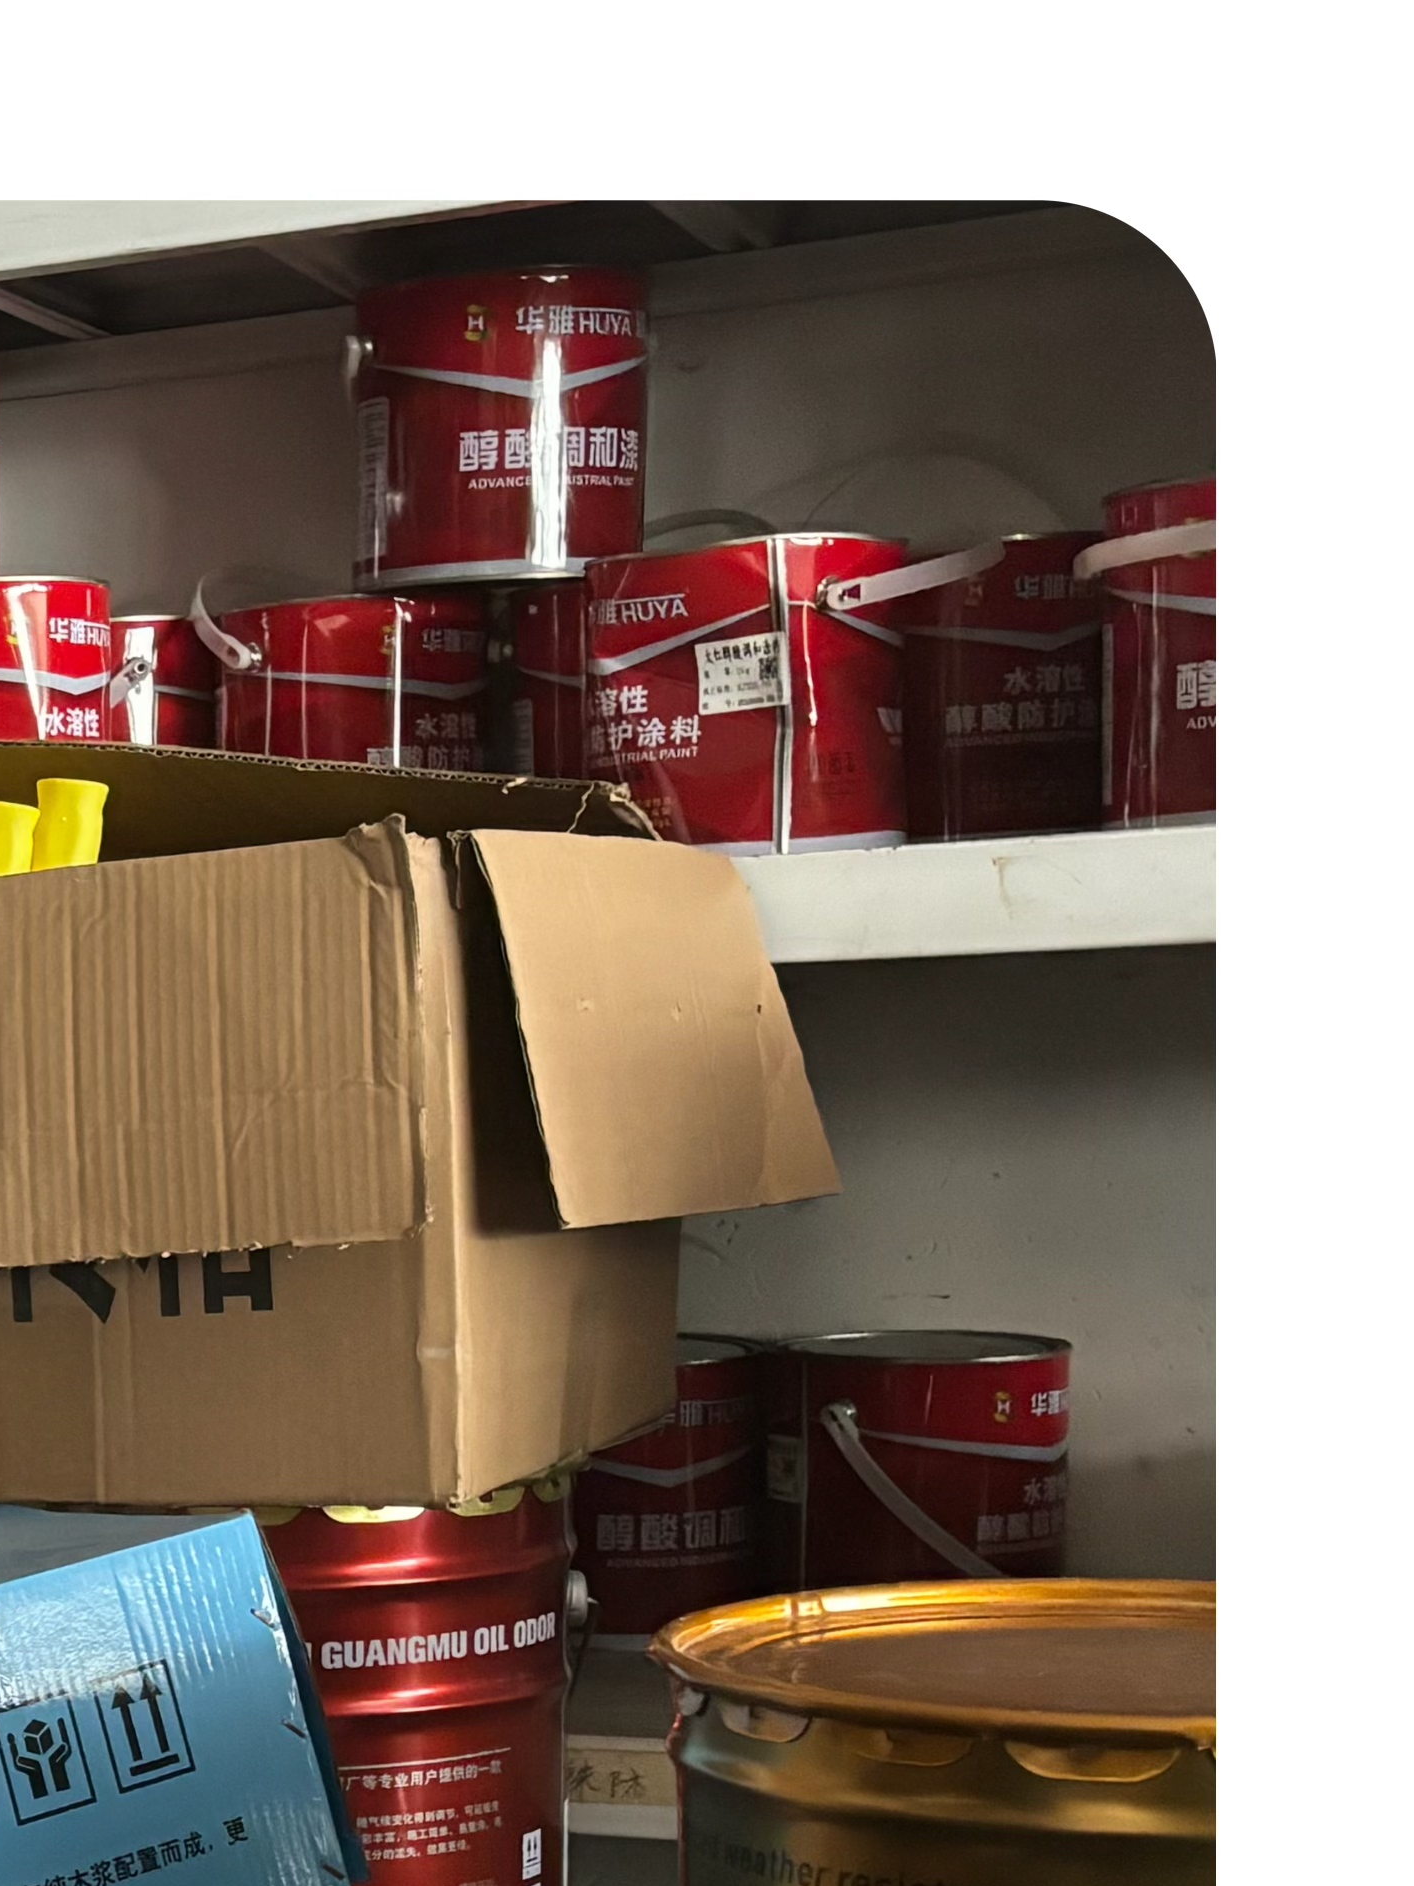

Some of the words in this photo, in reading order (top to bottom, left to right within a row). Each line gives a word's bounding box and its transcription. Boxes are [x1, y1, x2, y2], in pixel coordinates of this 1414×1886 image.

[468, 475, 533, 490] ADVANCE
[321, 1630, 468, 1671] GUANGMU
[473, 1620, 509, 1655] OIL
[513, 1611, 556, 1650] ODOR
